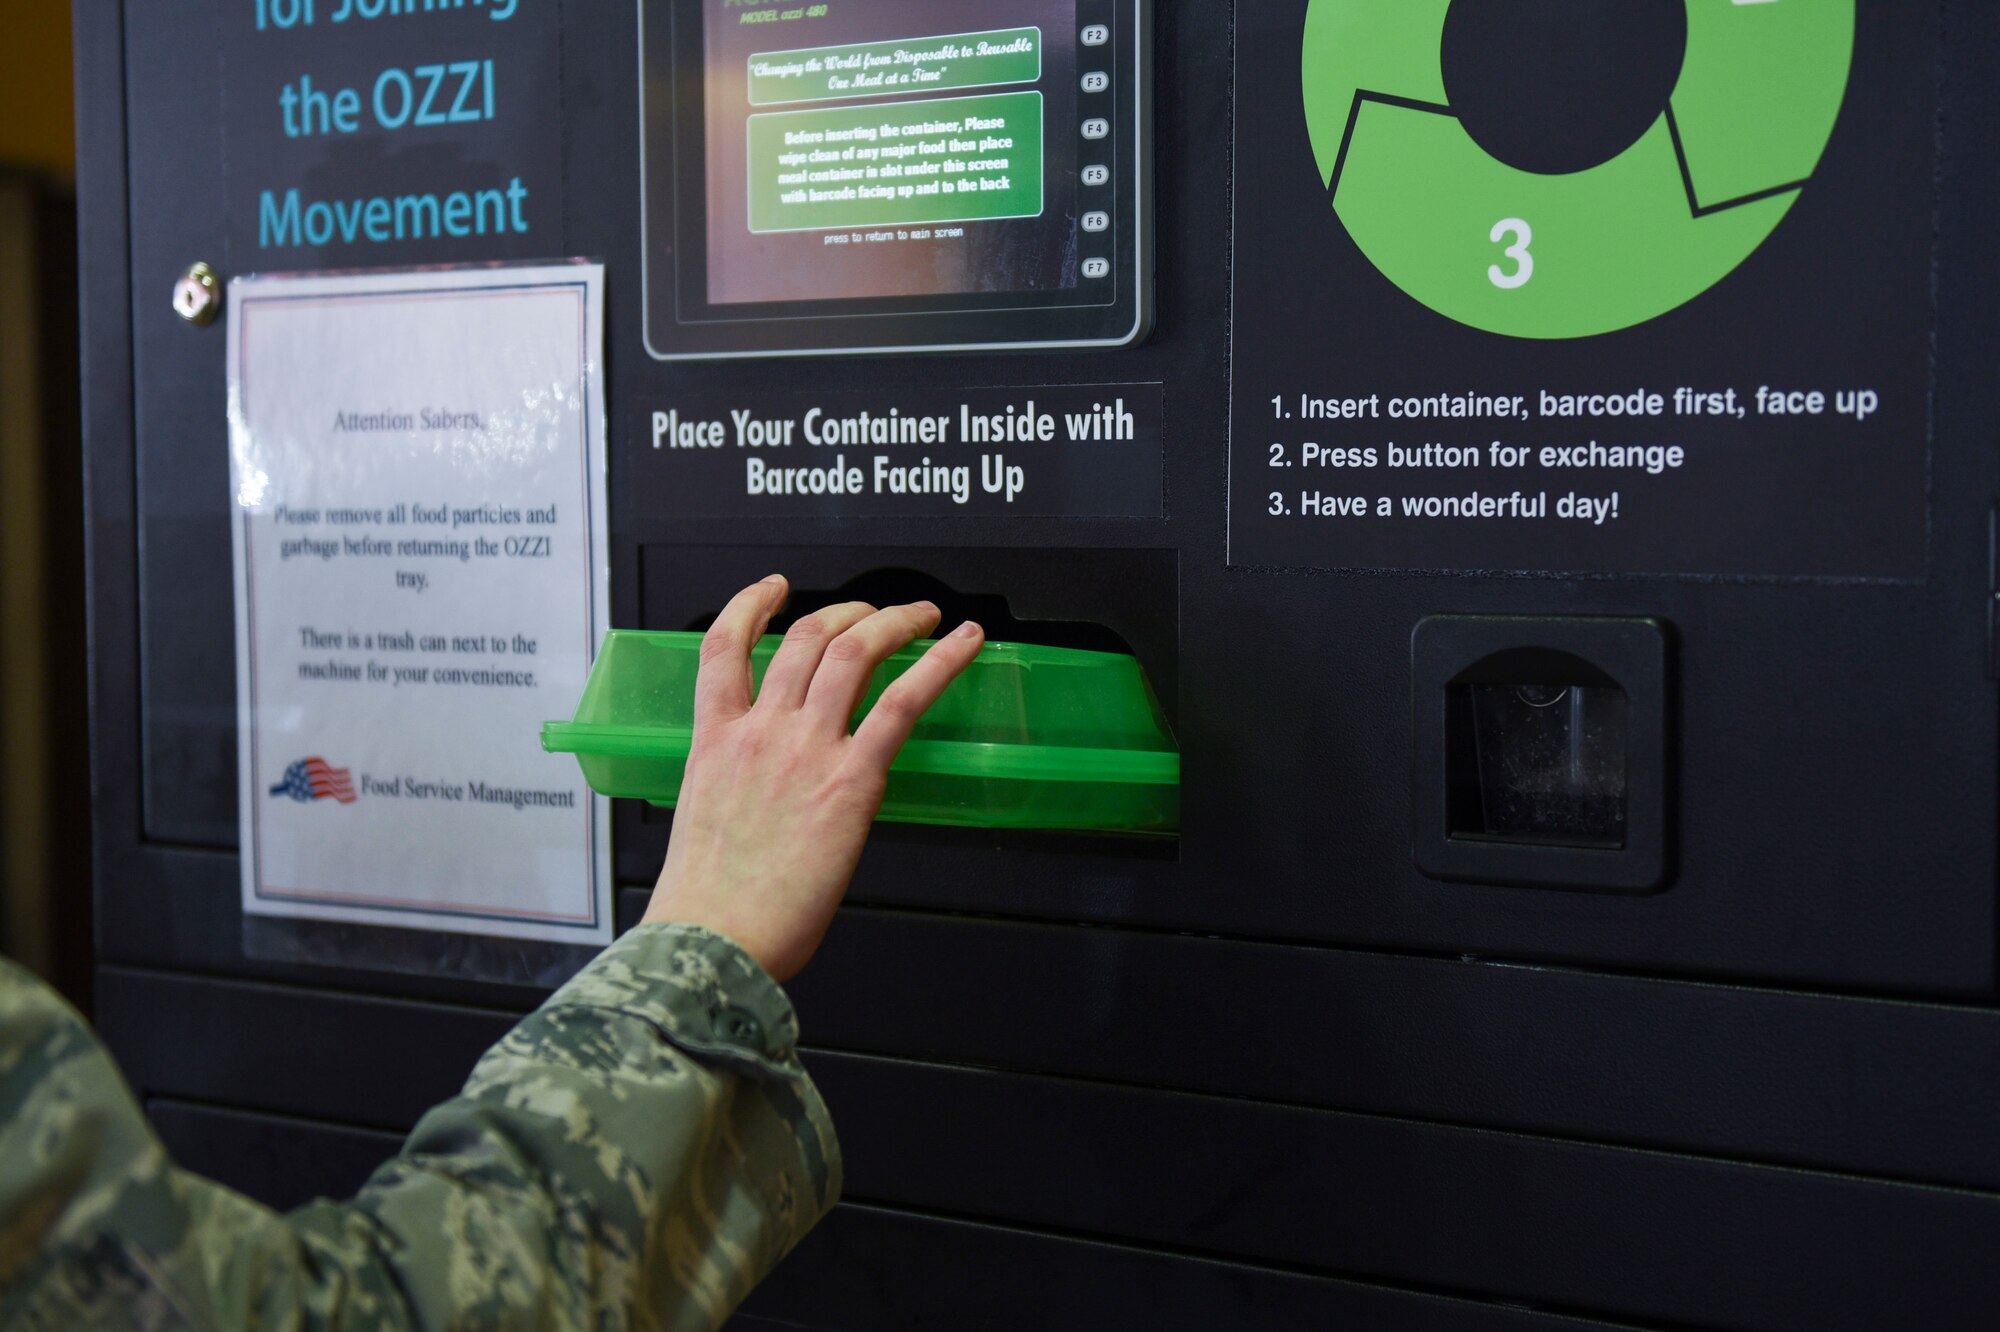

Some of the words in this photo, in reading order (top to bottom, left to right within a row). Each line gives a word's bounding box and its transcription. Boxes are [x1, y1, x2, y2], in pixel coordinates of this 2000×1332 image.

[739, 10, 778, 24] MODEL
[806, 4, 828, 17] 480
[805, 58, 822, 72] the
[824, 53, 862, 70] World
[863, 53, 891, 70] from
[893, 45, 959, 65] Disposable
[961, 45, 973, 57] to
[976, 37, 1032, 56] Reusable
[828, 75, 849, 90] One
[851, 72, 884, 88] Meal
[885, 72, 898, 85] at
[900, 73, 909, 83] a
[280, 74, 361, 138] the
[372, 59, 495, 130] OZZI
[784, 130, 823, 145] Before
[825, 126, 877, 141] inserting
[880, 124, 899, 137] the
[901, 120, 963, 133] container,
[965, 117, 1005, 130] Please
[778, 152, 807, 167] wipe
[808, 149, 840, 162] clean
[842, 146, 855, 160] of
[857, 147, 879, 161] any
[881, 144, 917, 159] major
[919, 140, 946, 154] food
[949, 139, 976, 152] then
[979, 136, 1013, 153] place
[778, 169, 808, 184] meal
[808, 168, 865, 182] container
[866, 165, 878, 178] in
[880, 164, 903, 177] slot
[905, 161, 941, 175] under
[943, 160, 966, 173] this
[968, 158, 1009, 171] screen
[780, 189, 807, 204] with
[809, 186, 857, 202] barcode
[858, 185, 896, 200] facing
[898, 185, 914, 198] up
[916, 180, 939, 195] and
[942, 181, 954, 193] to
[957, 178, 978, 192] the
[980, 176, 1011, 191] back
[259, 177, 529, 248] Movement
[824, 235, 849, 245] press
[852, 233, 862, 242] to
[865, 231, 894, 241] return
[898, 229, 908, 240] to
[910, 228, 931, 239] main
[934, 227, 963, 238] screen
[1487, 217, 1534, 289] 3
[1271, 394, 1291, 419] 1.
[1301, 393, 1379, 419] Insert
[1388, 390, 1529, 421] container,
[1539, 388, 1665, 416] barcode
[1673, 387, 1746, 419] first,
[1755, 385, 1826, 415] face
[1834, 389, 1879, 421] up
[332, 409, 414, 434] Attention
[419, 406, 486, 432] Sabers,
[651, 408, 725, 449] Place
[730, 409, 795, 448] Your
[803, 406, 950, 446] Container
[960, 400, 1056, 443] Inside
[1064, 397, 1135, 442] with
[1268, 443, 1292, 467] 2.
[1302, 442, 1378, 467] Press
[1388, 441, 1479, 467] button
[1488, 440, 1531, 467] for
[1539, 440, 1684, 474] exchange
[746, 455, 864, 496] Barcode
[873, 455, 971, 504] Facing
[981, 453, 1025, 503] Up
[274, 505, 321, 525] Please
[325, 506, 382, 525] remove
[387, 504, 406, 525] all
[411, 503, 448, 525] food
[452, 504, 521, 529] particles
[526, 503, 557, 525] and
[1268, 491, 1291, 516] 3.
[1301, 490, 1367, 517] Have
[1376, 495, 1392, 517] a
[1401, 490, 1546, 518] wonderful
[1556, 491, 1619, 526] day!
[280, 536, 340, 562] garbage
[343, 536, 393, 556] before
[397, 537, 470, 562] returning
[474, 536, 499, 556] the
[503, 536, 552, 557] OZZI
[395, 569, 430, 593] tray.
[299, 626, 342, 649] There
[347, 629, 360, 650] is
[363, 634, 373, 651] a
[377, 630, 415, 651] trash
[419, 636, 446, 652] can
[451, 634, 488, 654] next
[490, 634, 507, 655] to
[511, 633, 538, 656] the
[298, 658, 361, 681] machine
[366, 659, 389, 682] for
[392, 664, 430, 688] your
[433, 665, 538, 688] convenience.
[361, 774, 400, 796] Food
[404, 777, 464, 801] Service
[467, 781, 576, 809] Management
